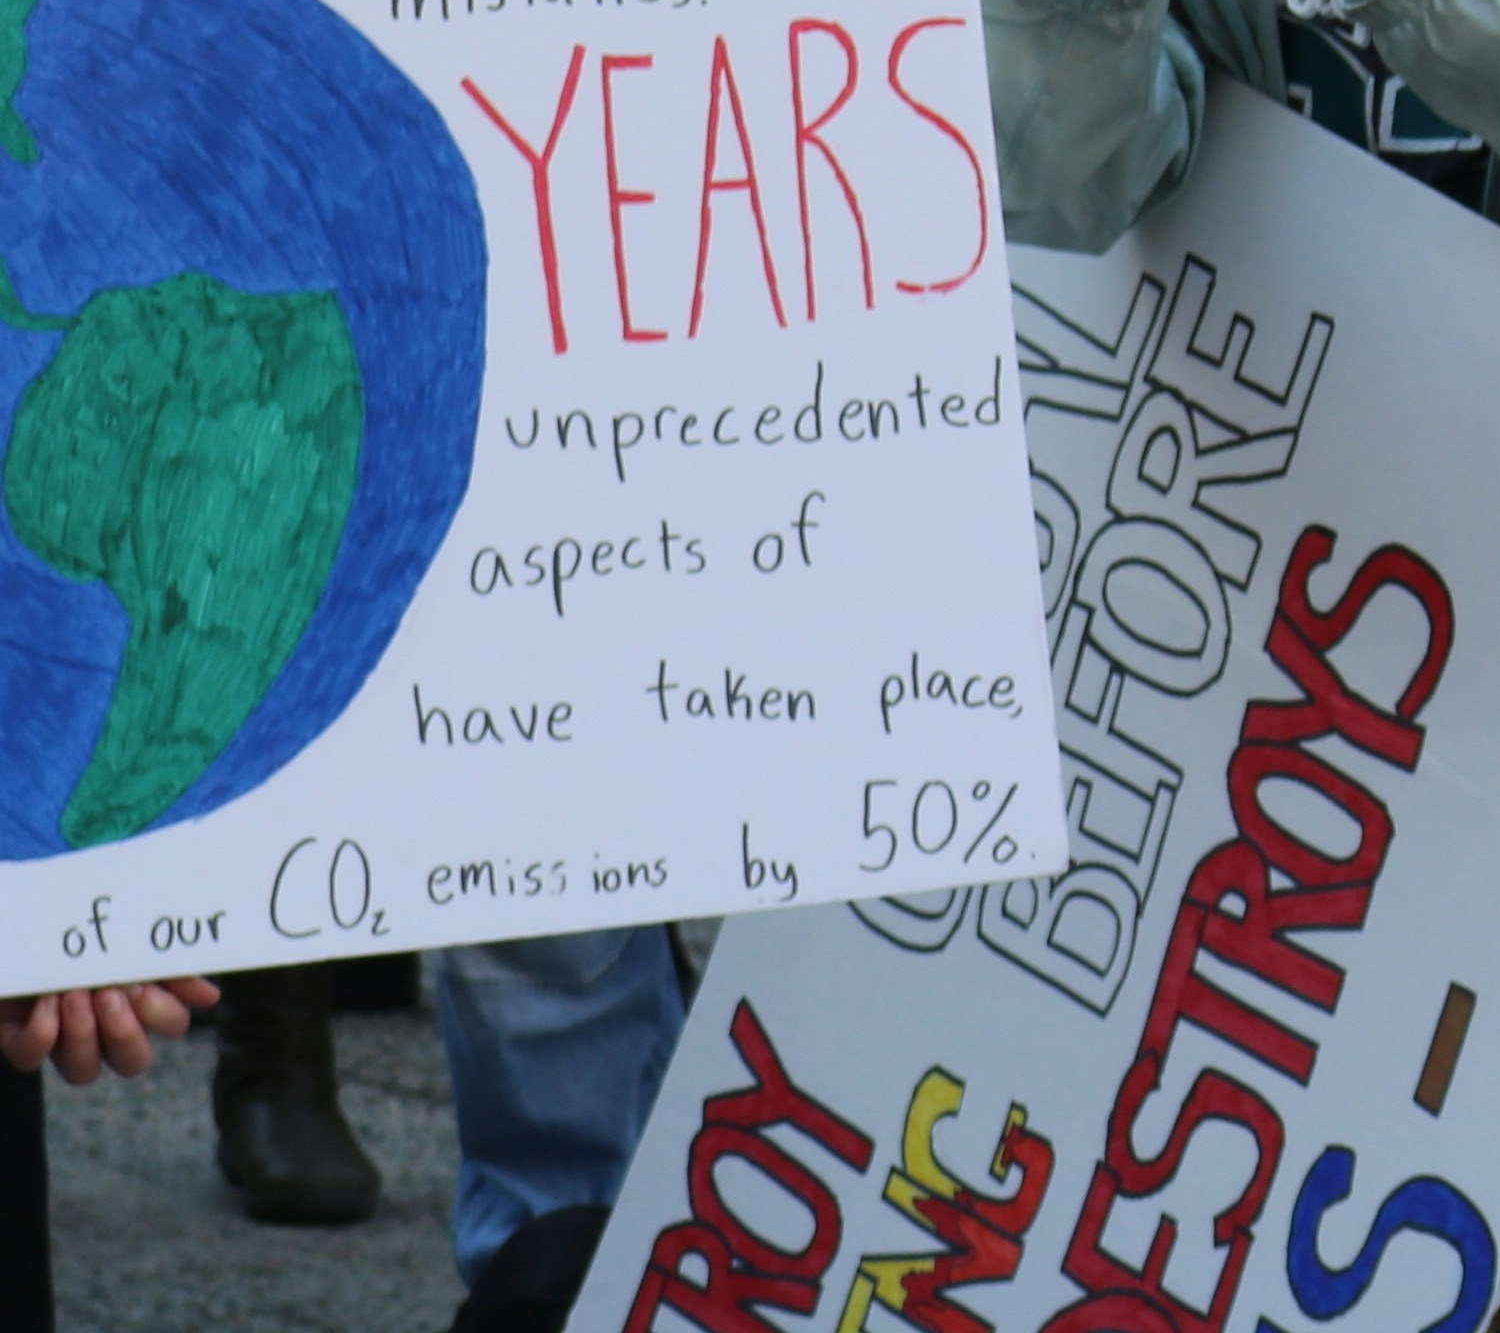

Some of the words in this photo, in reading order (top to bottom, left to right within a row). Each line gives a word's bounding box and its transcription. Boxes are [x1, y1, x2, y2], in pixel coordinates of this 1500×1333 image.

[460, 17, 988, 355] YEARS
[504, 357, 1003, 481] unprecedented
[469, 517, 707, 615] aspects
[752, 491, 825, 574] of
[978, 253, 1334, 1016] BEFORE
[415, 683, 573, 746] have
[646, 659, 816, 724] taken
[879, 653, 1023, 735] place,
[64, 897, 111, 957] of
[150, 910, 226, 952] our
[427, 852, 669, 905] emissions
[742, 824, 800, 900] by
